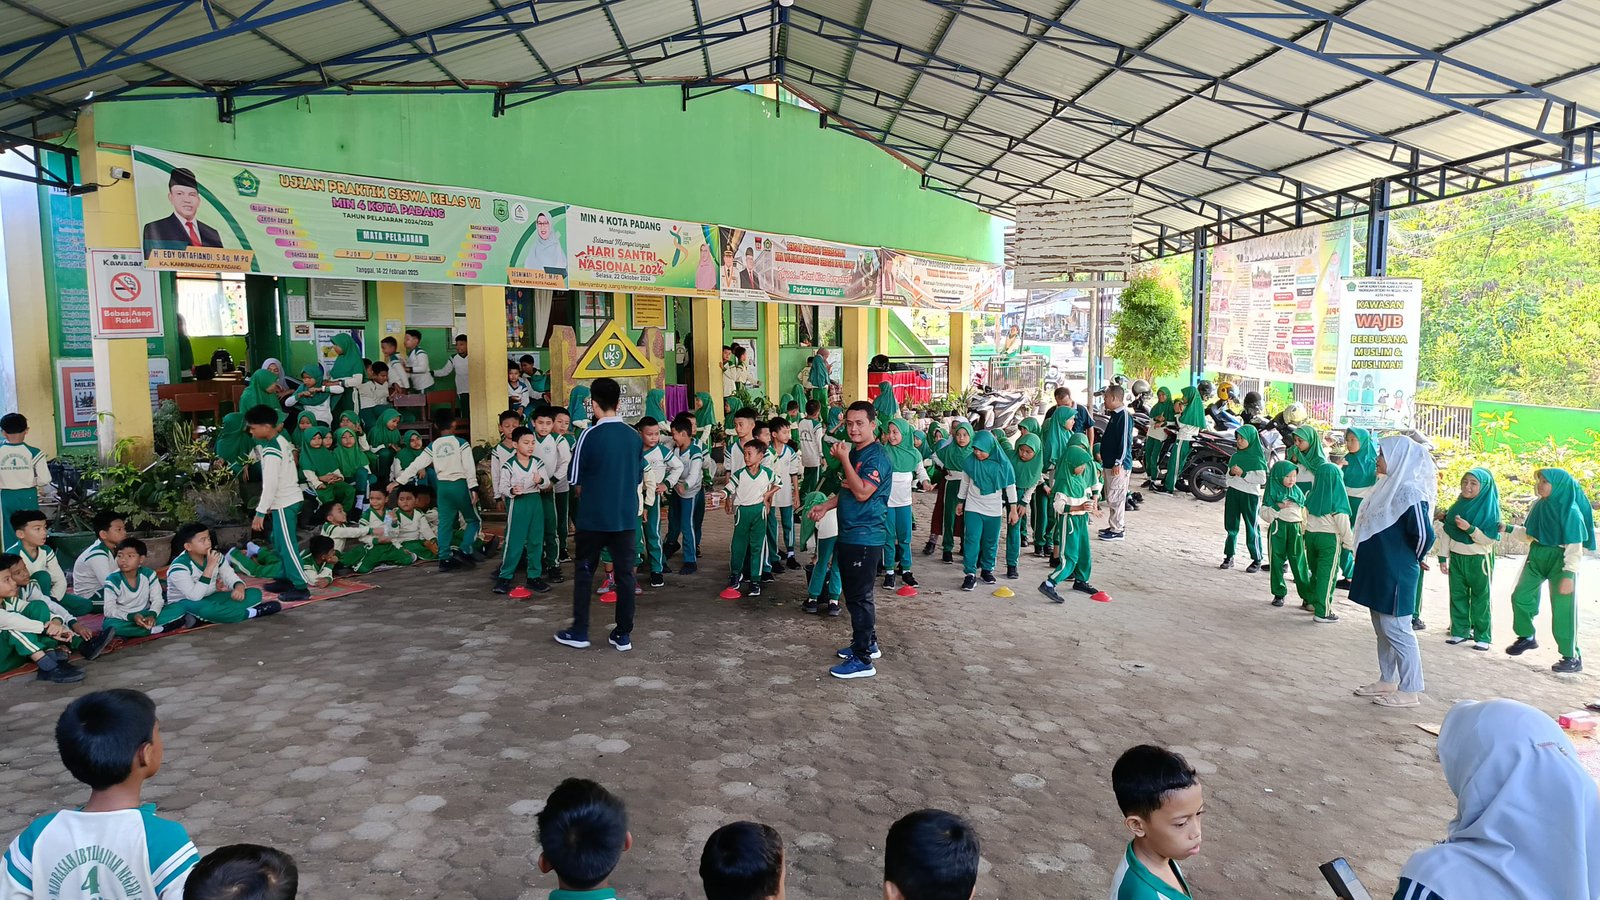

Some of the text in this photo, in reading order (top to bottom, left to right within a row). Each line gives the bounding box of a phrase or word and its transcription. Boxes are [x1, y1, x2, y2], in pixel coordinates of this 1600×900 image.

[279, 173, 481, 209] UJIAN PRAKTIK SISWA KELAS VI
[332, 197, 445, 218] MIN 4 KOTA PADANG
[367, 215, 403, 223] PELAJARAN
[404, 218, 434, 226] 2024/2025
[580, 212, 661, 231] MIN 4 KOTA PADANG
[363, 231, 423, 243] MATA PELAJARAN
[163, 250, 175, 258] EDY
[587, 245, 656, 261] HARI SANTRI
[579, 258, 665, 275] NASIONAL 2024
[792, 286, 841, 296] Padang Kota Wakaf
[1356, 300, 1404, 309] KAWASAN
[131, 310, 151, 318] Asap
[1355, 314, 1403, 331] WAJIB
[1350, 334, 1408, 343] BERBUSANA
[604, 351, 620, 360] UKS
[1354, 347, 1402, 356] MUSLIM &
[1352, 360, 1404, 369] MUSLIMAH
[48, 853, 77, 896] MADRASAH
[116, 865, 142, 897] NEGERI
[81, 865, 100, 895] 4
